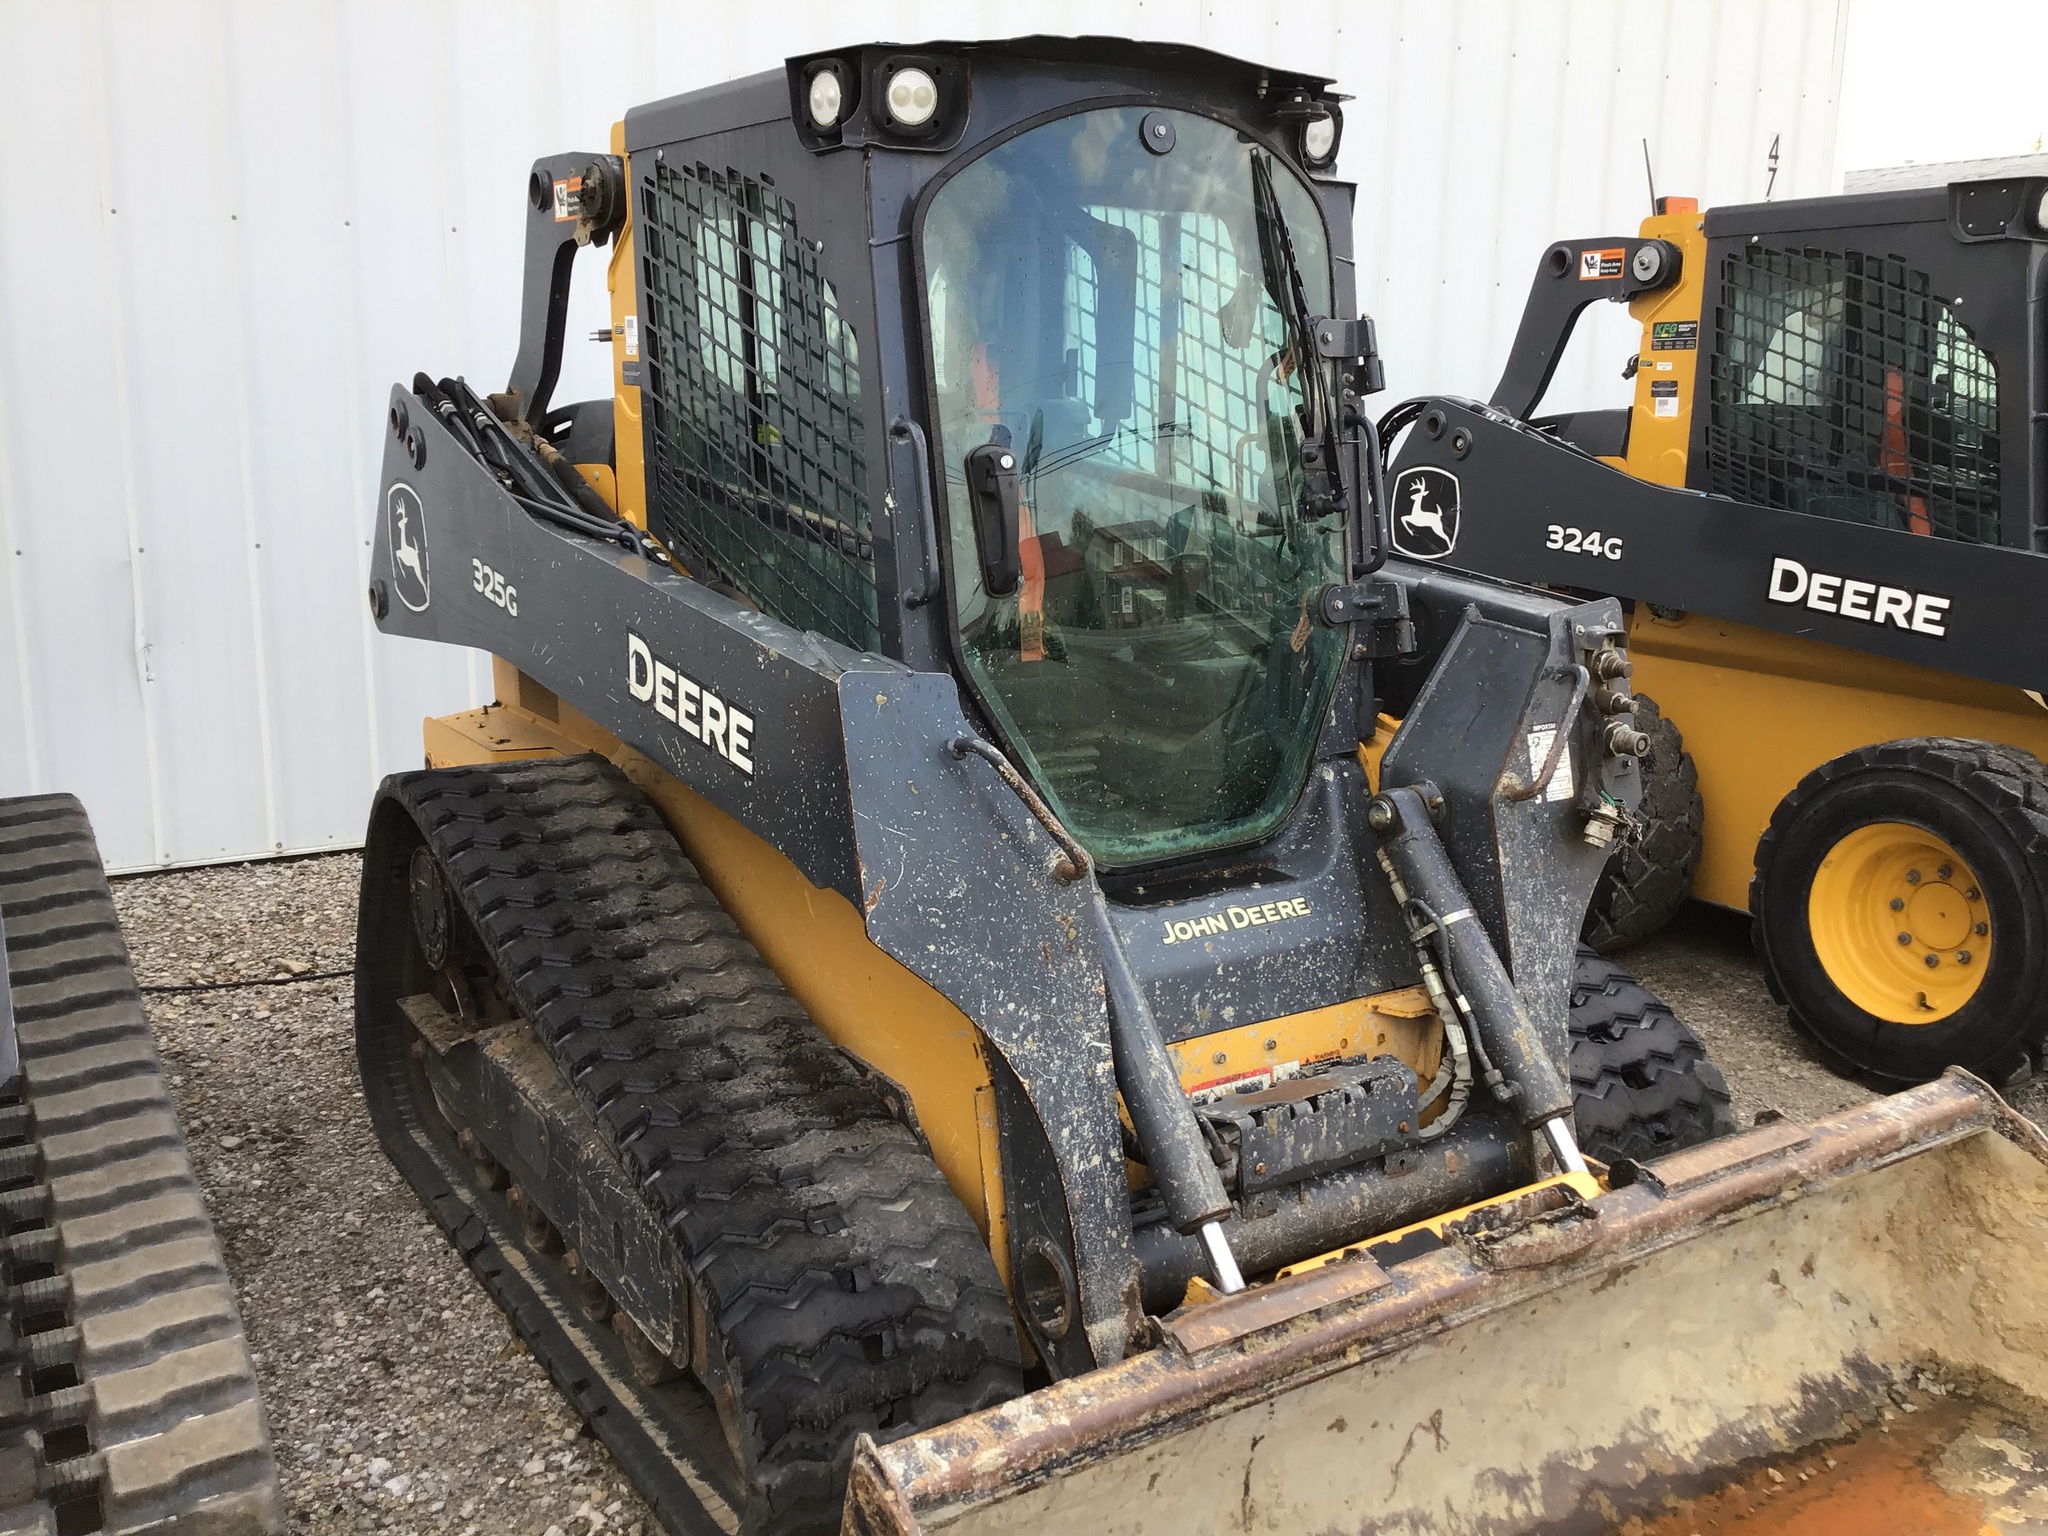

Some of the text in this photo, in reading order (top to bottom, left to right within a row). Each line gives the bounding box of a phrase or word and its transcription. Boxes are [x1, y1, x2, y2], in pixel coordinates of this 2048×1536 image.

[1655, 323, 1678, 334] KFG
[1545, 524, 1623, 561] 324G
[471, 557, 518, 617] 325G
[1768, 557, 1950, 637] DEERE
[627, 633, 755, 776] DEERE
[1162, 896, 1312, 945] JOHN DEERE
